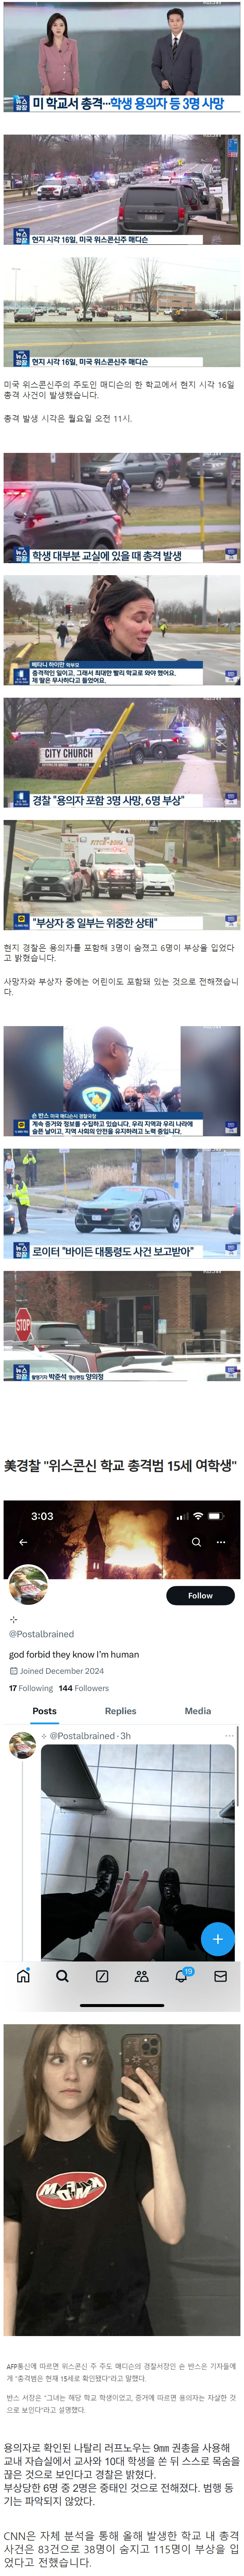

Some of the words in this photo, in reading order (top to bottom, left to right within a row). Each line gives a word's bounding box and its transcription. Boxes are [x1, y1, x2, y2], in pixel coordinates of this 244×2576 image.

[45, 749, 61, 758] CITY
[63, 749, 93, 758] CHURCH
[16, 1319, 30, 1331] STOP
[31, 1512, 53, 1520] 3:03
[9, 1650, 24, 1660] god
[52, 1650, 71, 1660] they
[19, 1684, 53, 1693] Following
[105, 1707, 136, 1716] Replies
